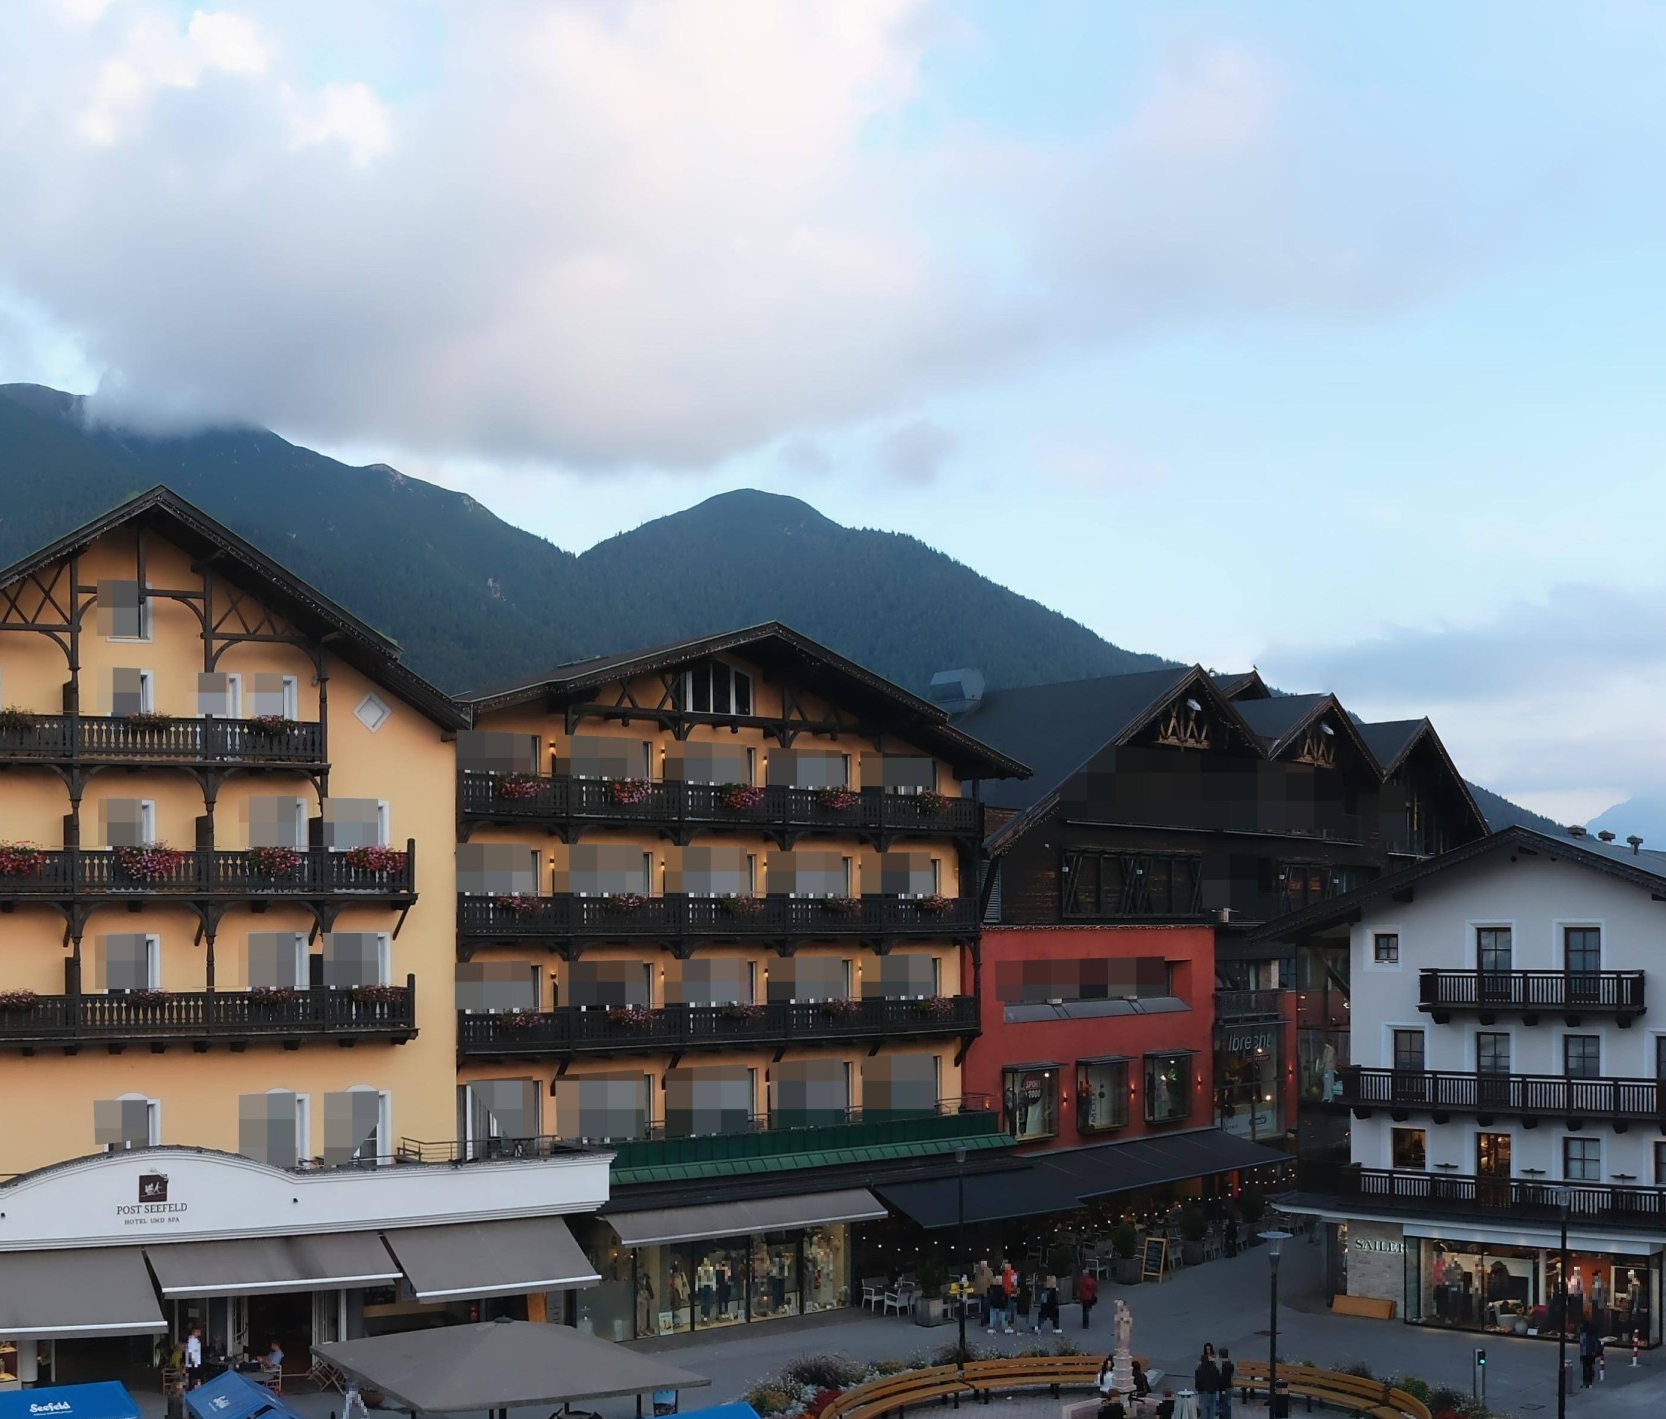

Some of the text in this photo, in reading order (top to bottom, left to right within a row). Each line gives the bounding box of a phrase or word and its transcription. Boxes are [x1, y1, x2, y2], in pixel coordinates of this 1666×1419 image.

[117, 1203, 188, 1215] POST SEEFELD
[1355, 1239, 1408, 1254] SAILER
[29, 1401, 71, 1413] Seefeld
